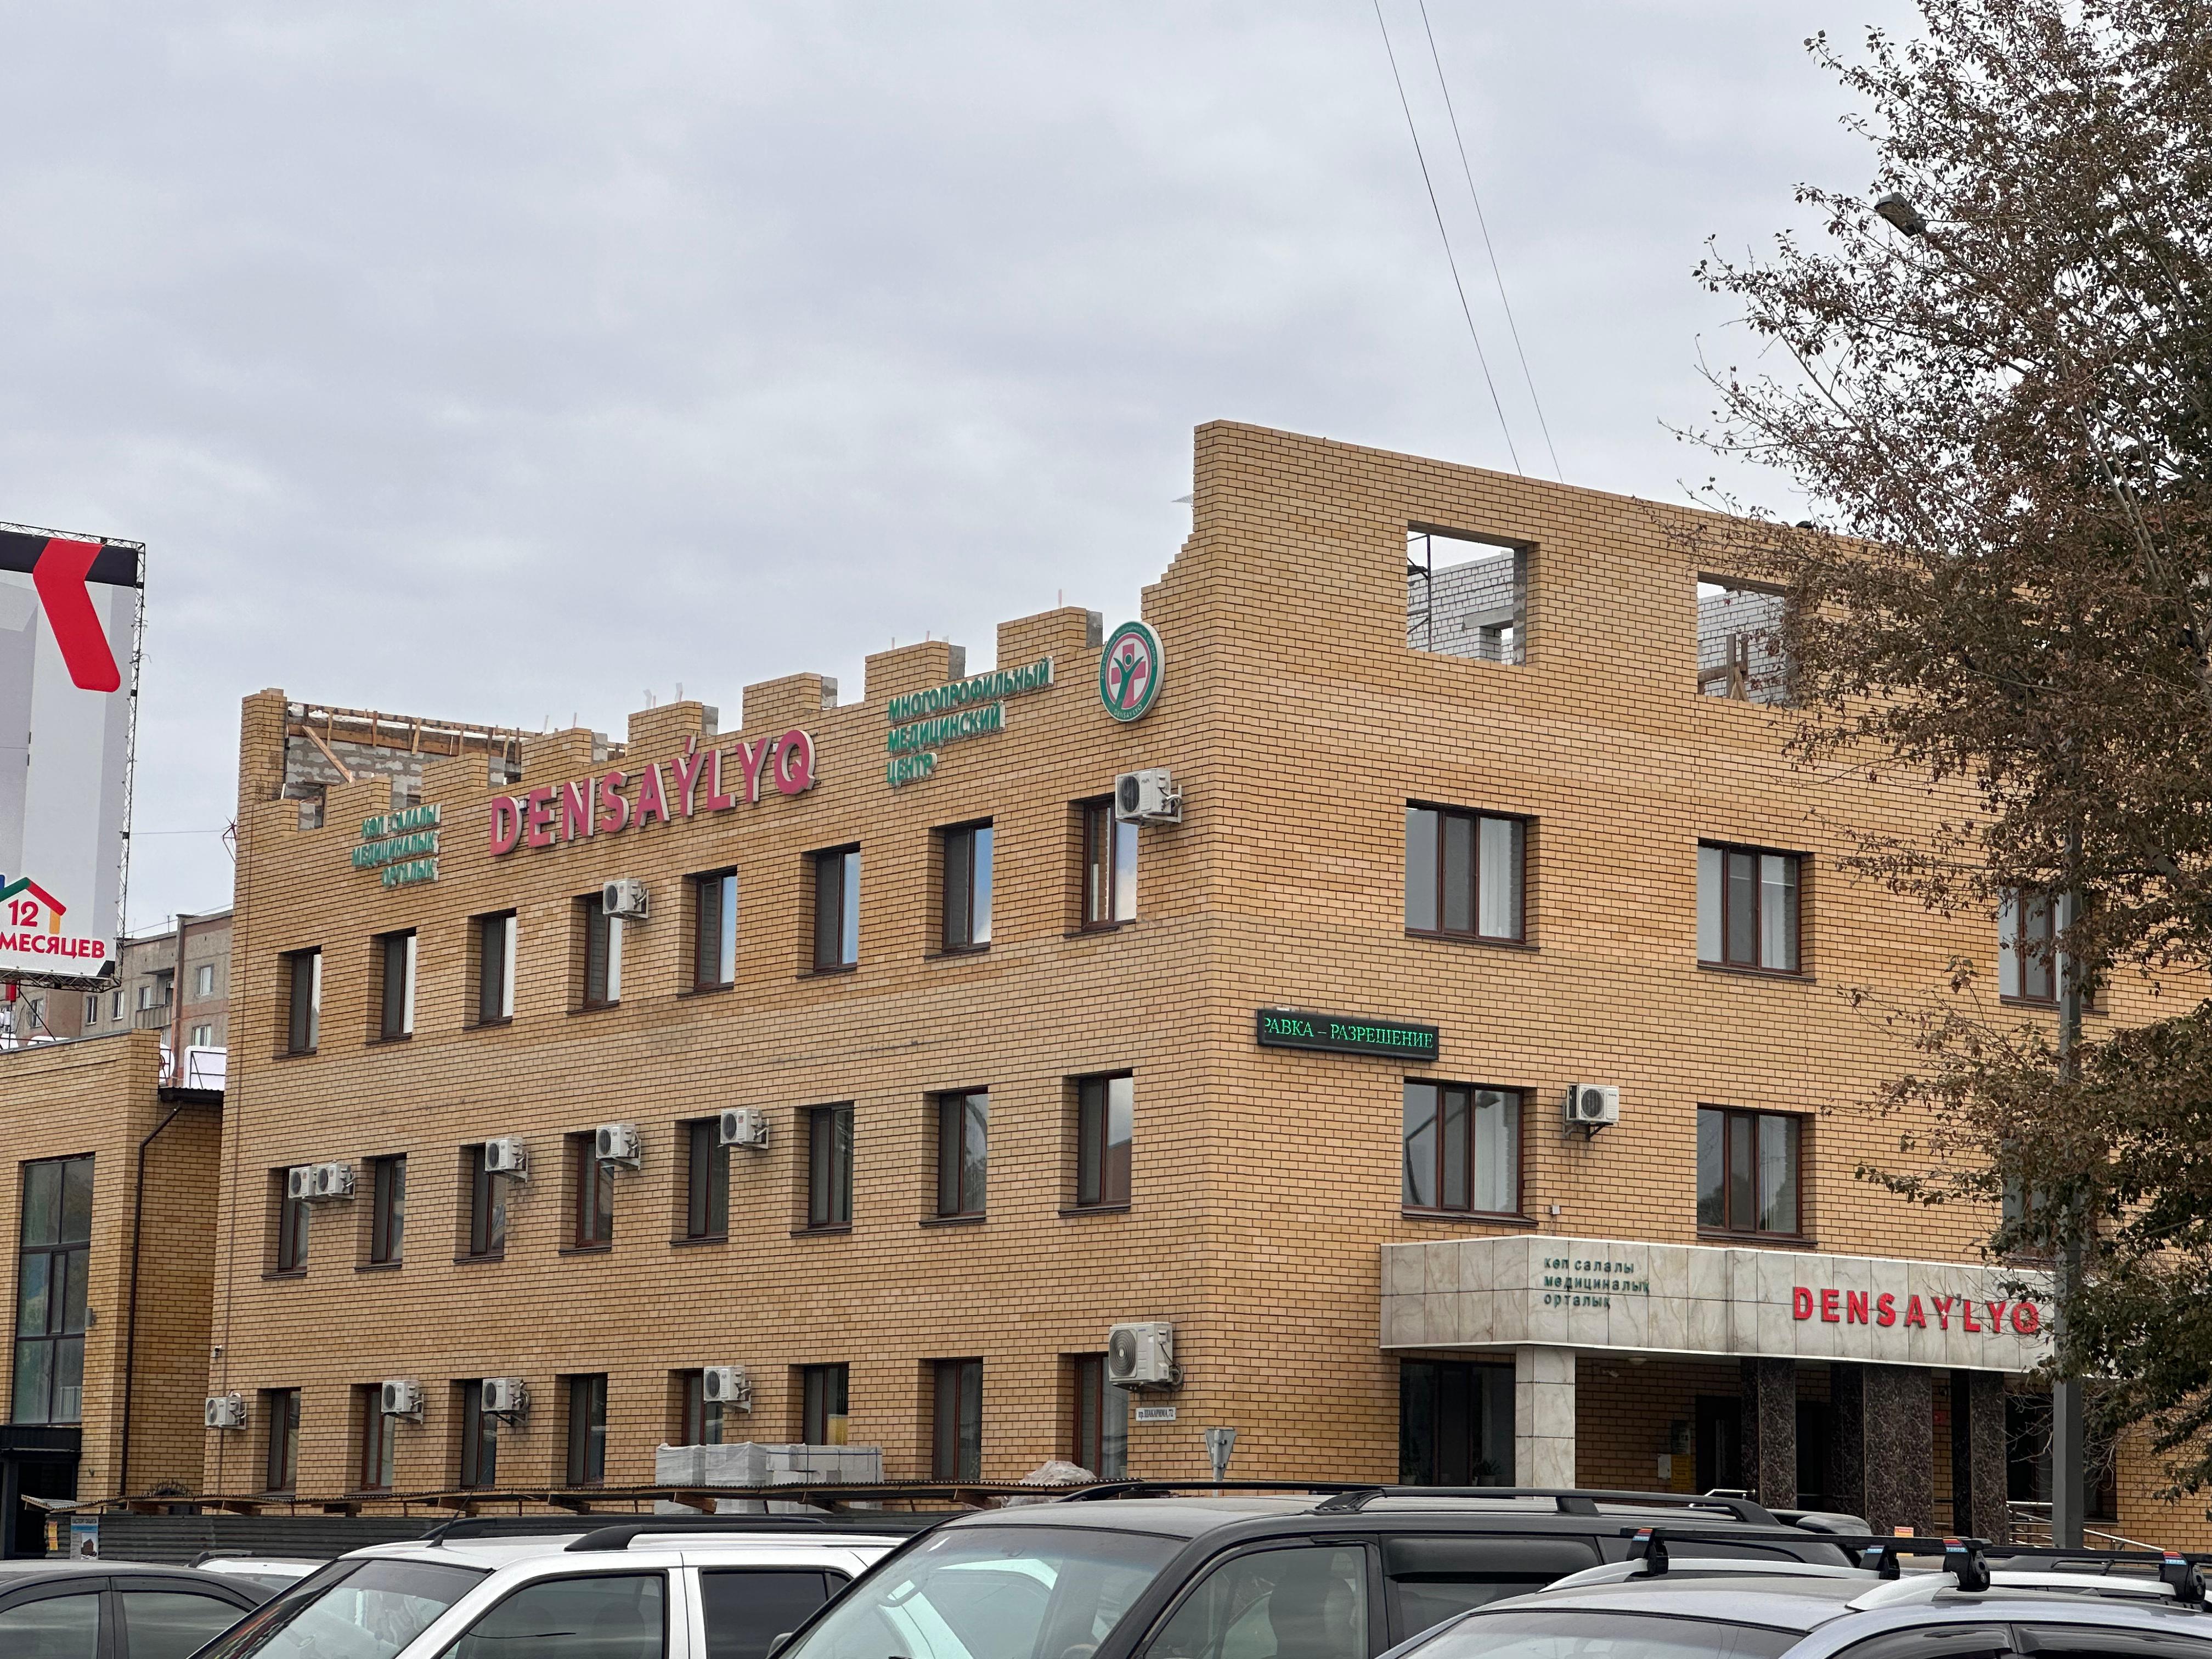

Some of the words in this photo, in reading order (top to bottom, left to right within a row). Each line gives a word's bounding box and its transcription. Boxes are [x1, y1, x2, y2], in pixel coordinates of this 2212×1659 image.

[888, 656, 1054, 723] МНОГОПРОФИЛЬНЫЙ
[887, 700, 1005, 754] МЕДИЦИНСКИЙ
[887, 752, 938, 788] ЦЕНТР
[8, 900, 38, 927] 12
[0, 932, 105, 959] МЕСЯЦЕВ
[1330, 1024, 1434, 1048] РАЗРЕШЕНИЕ
[1575, 1260, 1634, 1273] салалы
